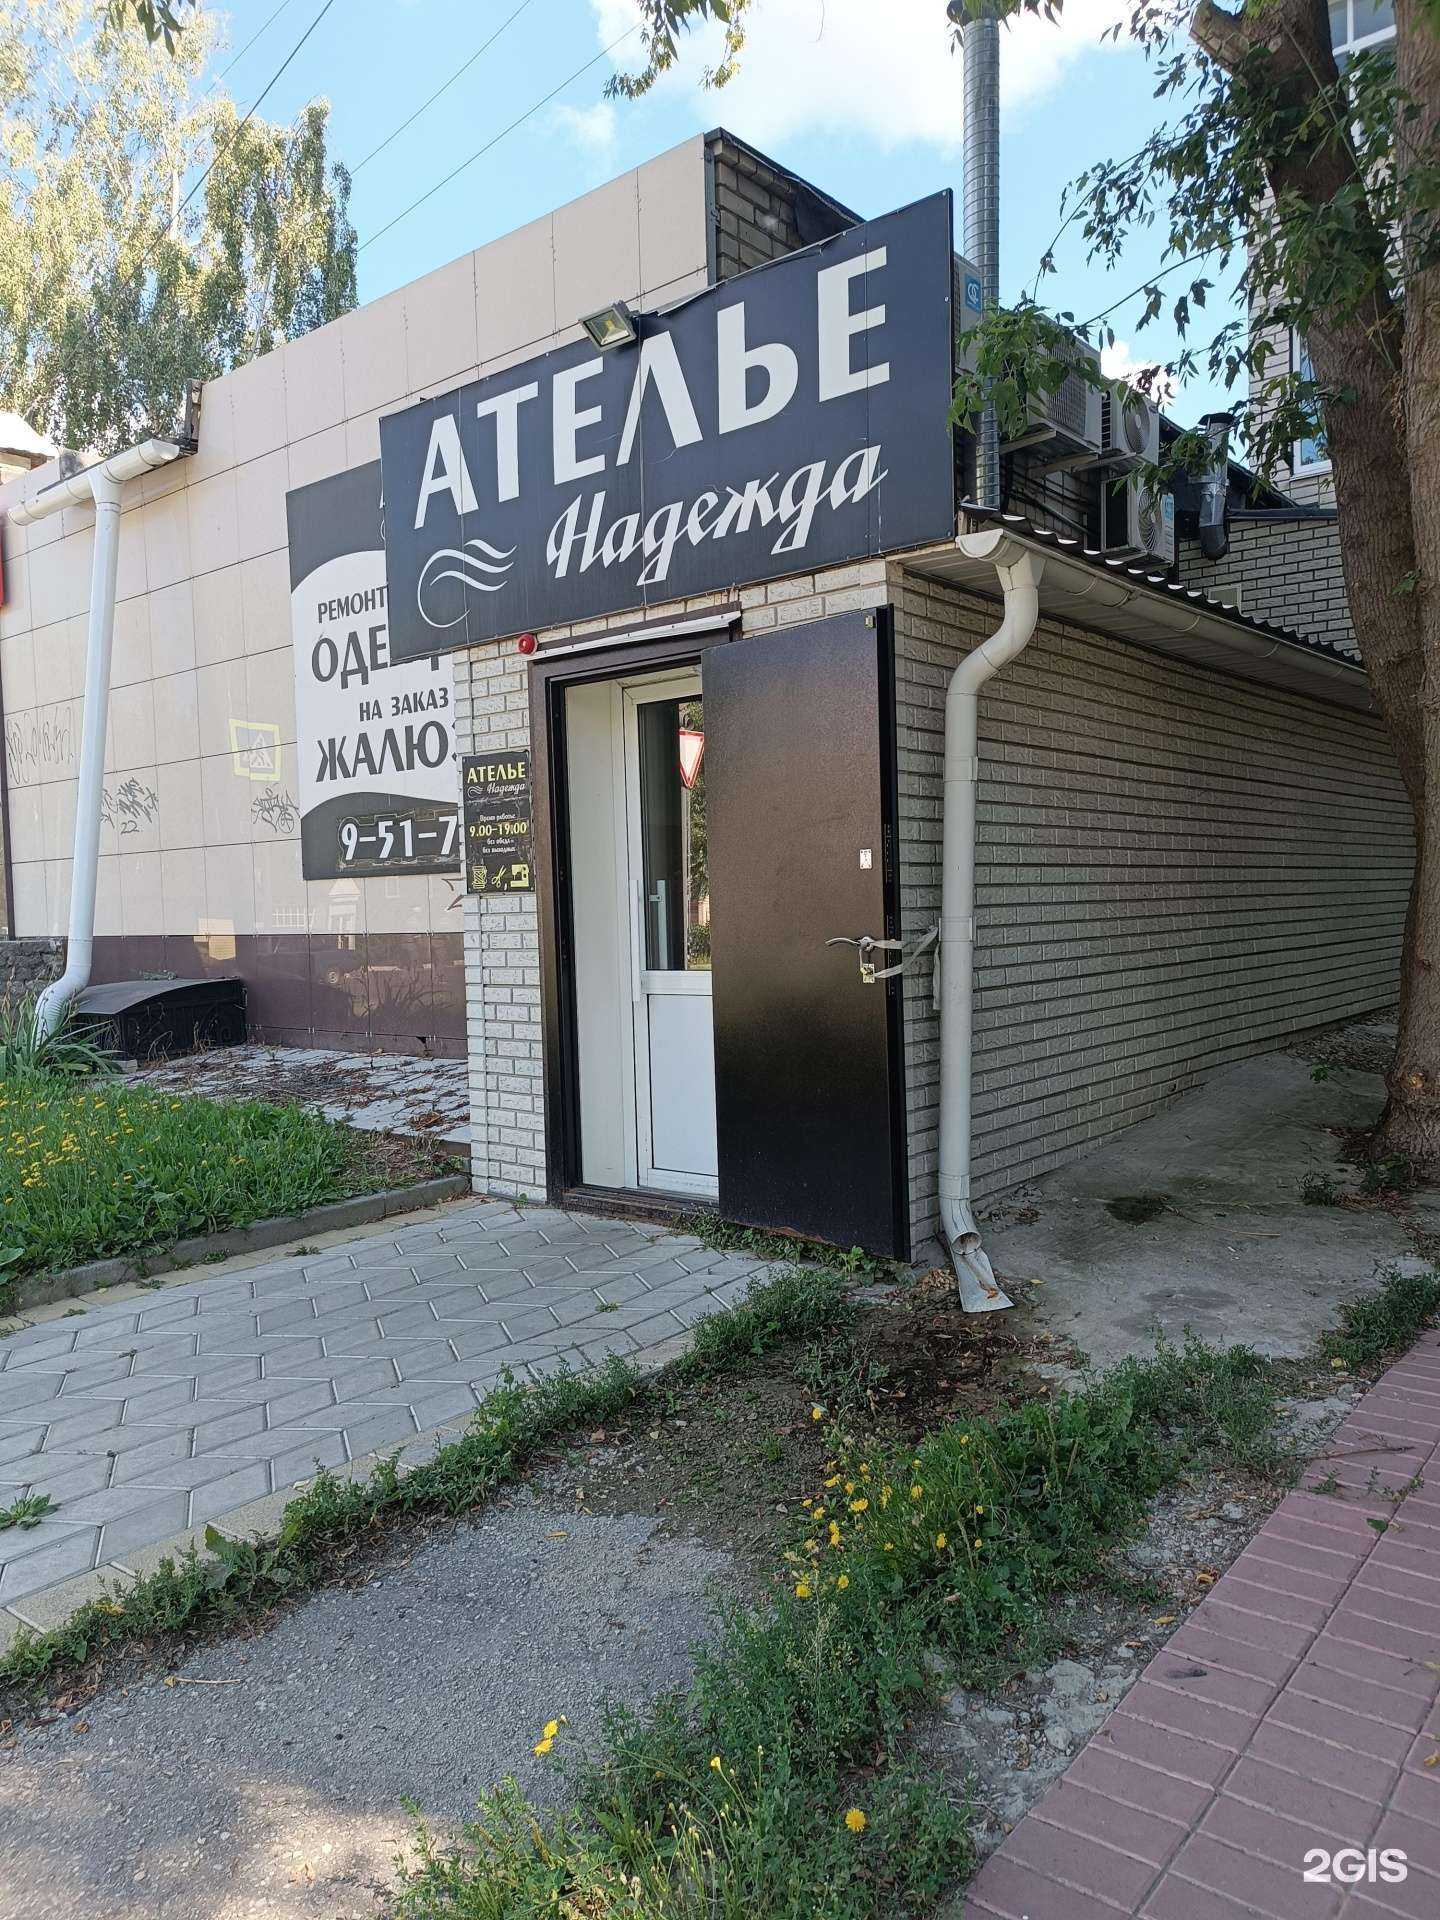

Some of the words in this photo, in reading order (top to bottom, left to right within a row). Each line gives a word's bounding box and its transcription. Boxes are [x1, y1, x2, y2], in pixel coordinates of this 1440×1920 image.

[413, 245, 891, 530] АТЕЛЬЕ
[546, 444, 888, 587] Надежда
[317, 585, 388, 624] РЕМОНТ
[359, 699, 383, 722] НА
[391, 687, 449, 717] ЗАКАЗ
[316, 720, 457, 783] ЖАЛЮ
[467, 762, 526, 784] АТЕЛЬЕ
[486, 782, 526, 795] Надежда
